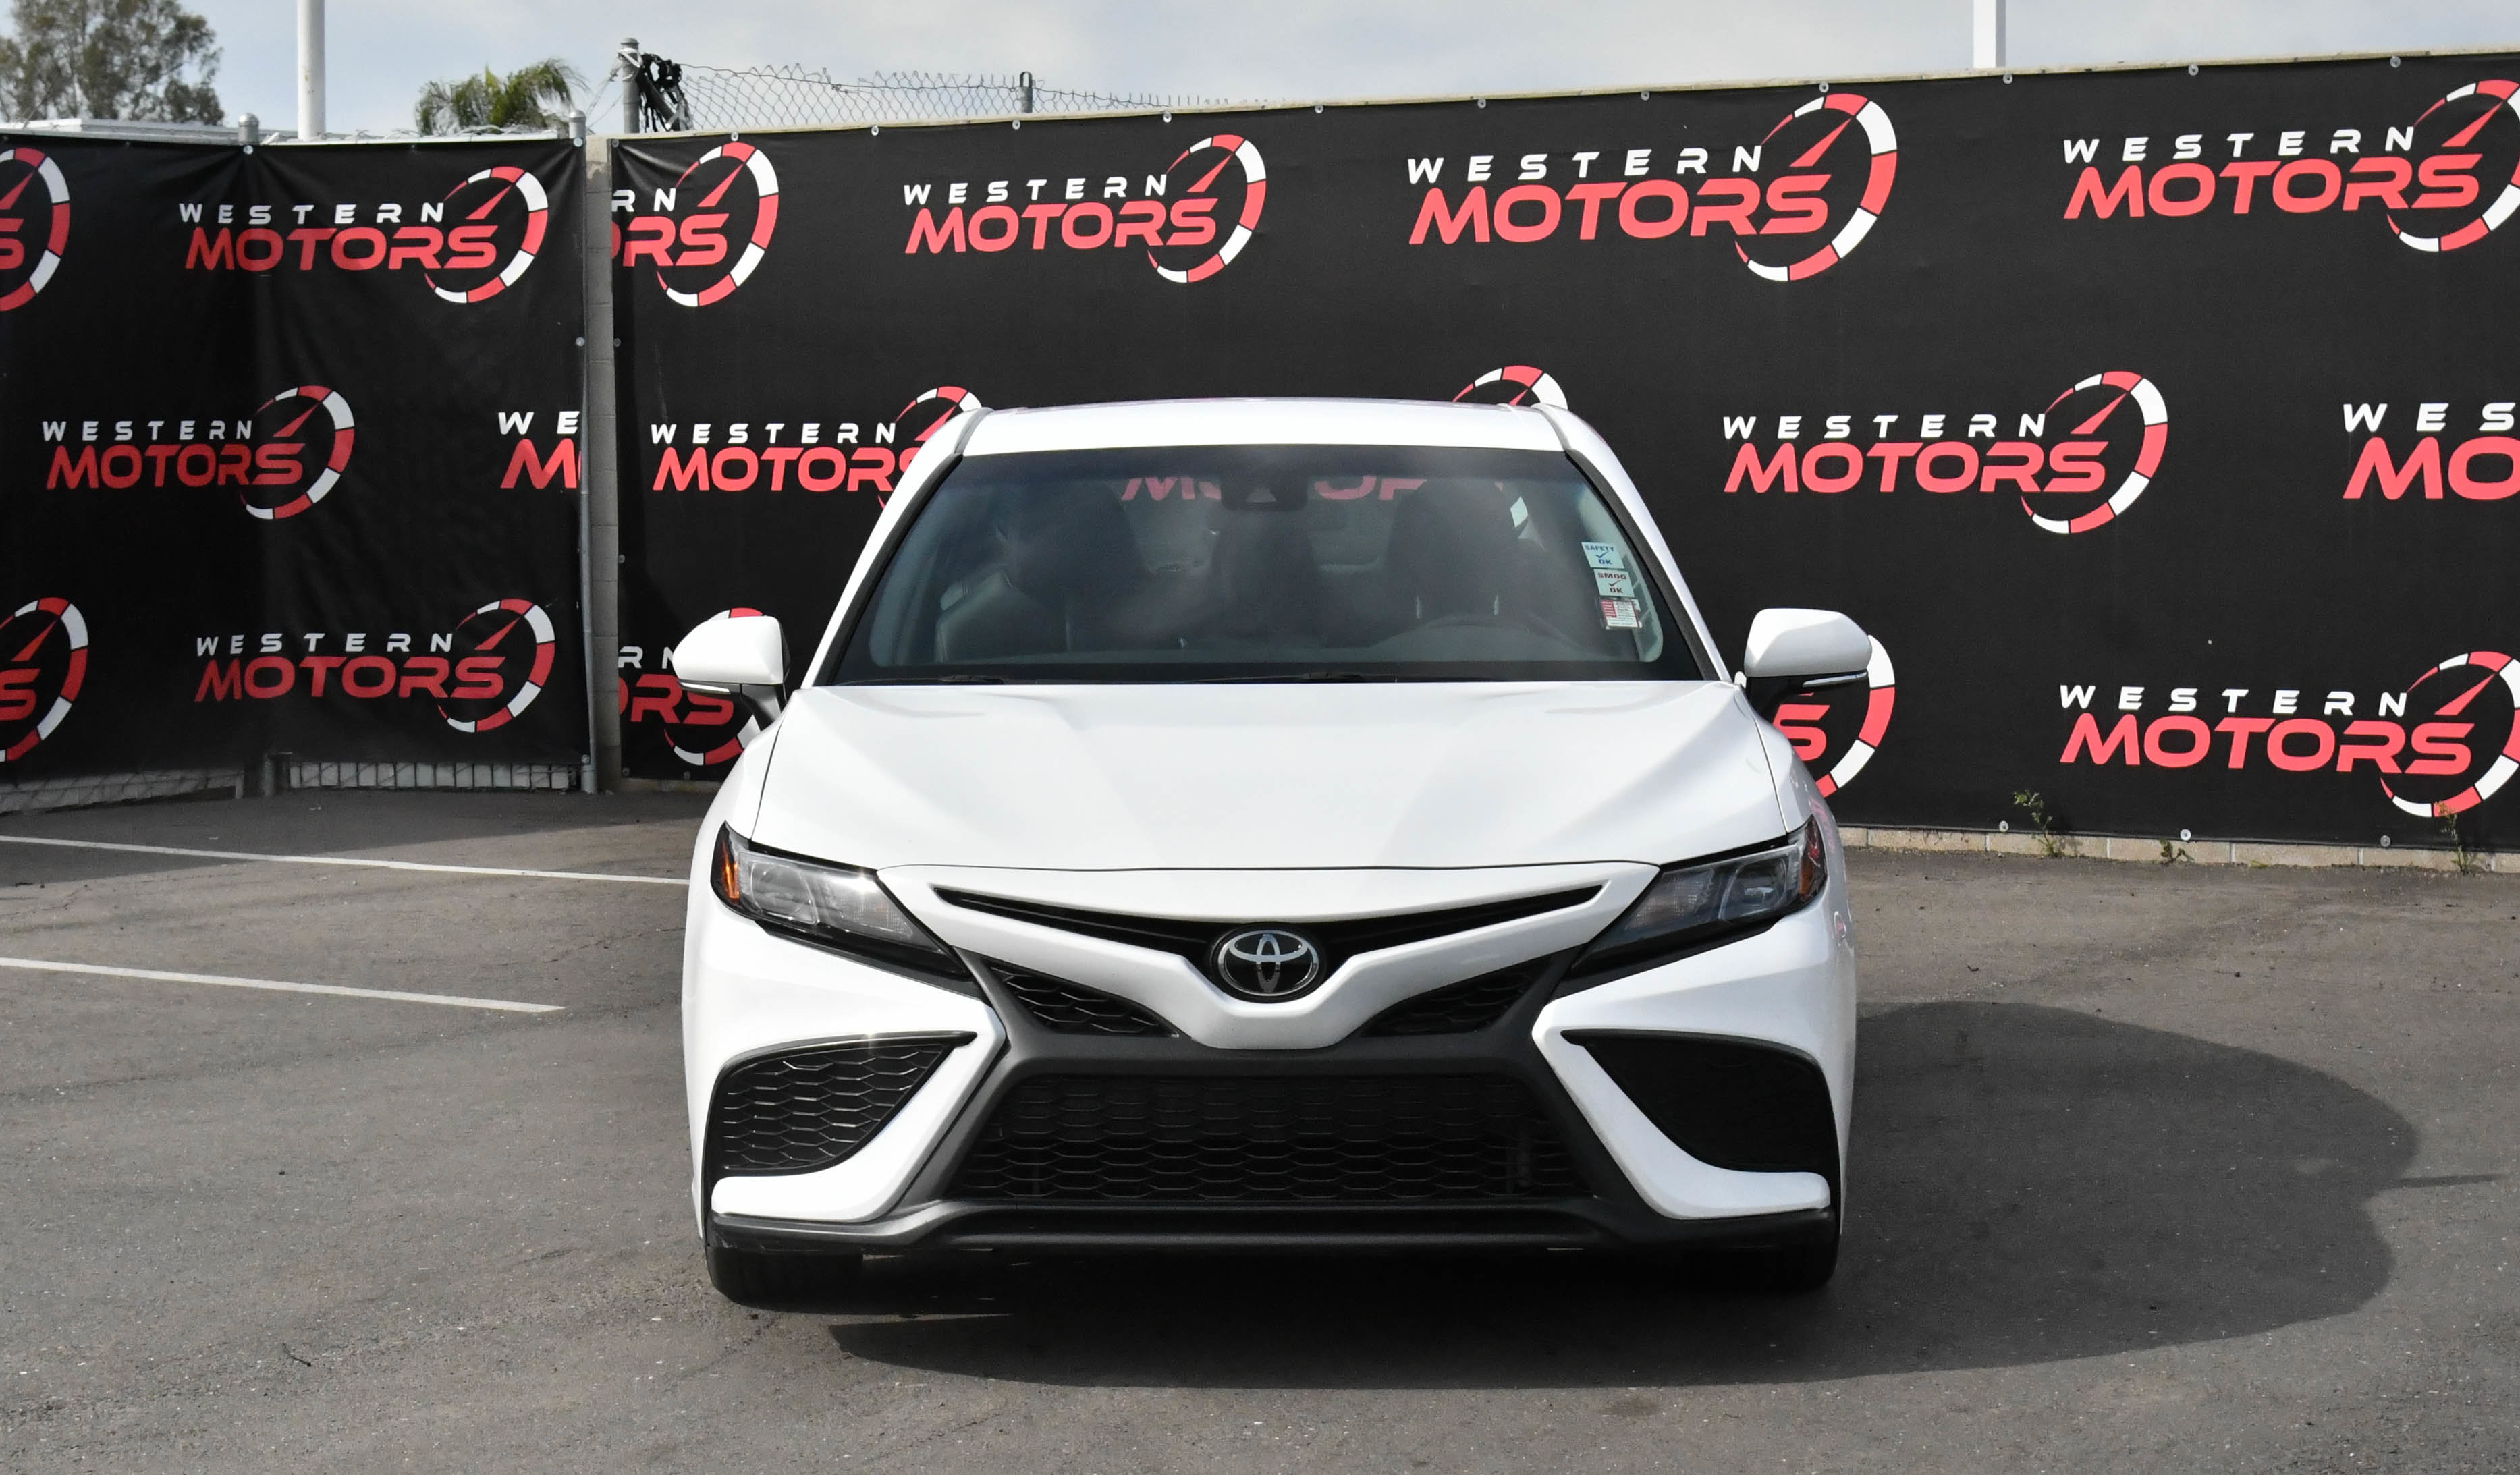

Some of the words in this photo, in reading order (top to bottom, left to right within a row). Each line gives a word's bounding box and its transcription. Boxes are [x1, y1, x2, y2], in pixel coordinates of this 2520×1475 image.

[1407, 145, 1762, 184] WESTERN
[2063, 126, 2414, 164] WESTERN
[903, 173, 1167, 206] WESTERN
[2064, 152, 2484, 220] MOTORS
[179, 202, 444, 225] WESTERN
[904, 197, 1219, 254] MOTORS
[1408, 173, 1832, 246] MOTORS
[186, 224, 499, 272] MOTORS
[43, 420, 252, 441] WESTERN
[651, 422, 896, 445] WESTERN
[1723, 413, 2046, 440] WESTERN
[47, 443, 304, 489] MOTORS
[1724, 440, 2109, 494] MOTORS
[197, 633, 453, 656] WESTERN
[196, 655, 505, 702] MOTORS
[2060, 684, 2407, 717] WESTERN
[2060, 712, 2475, 776] MOTORS
